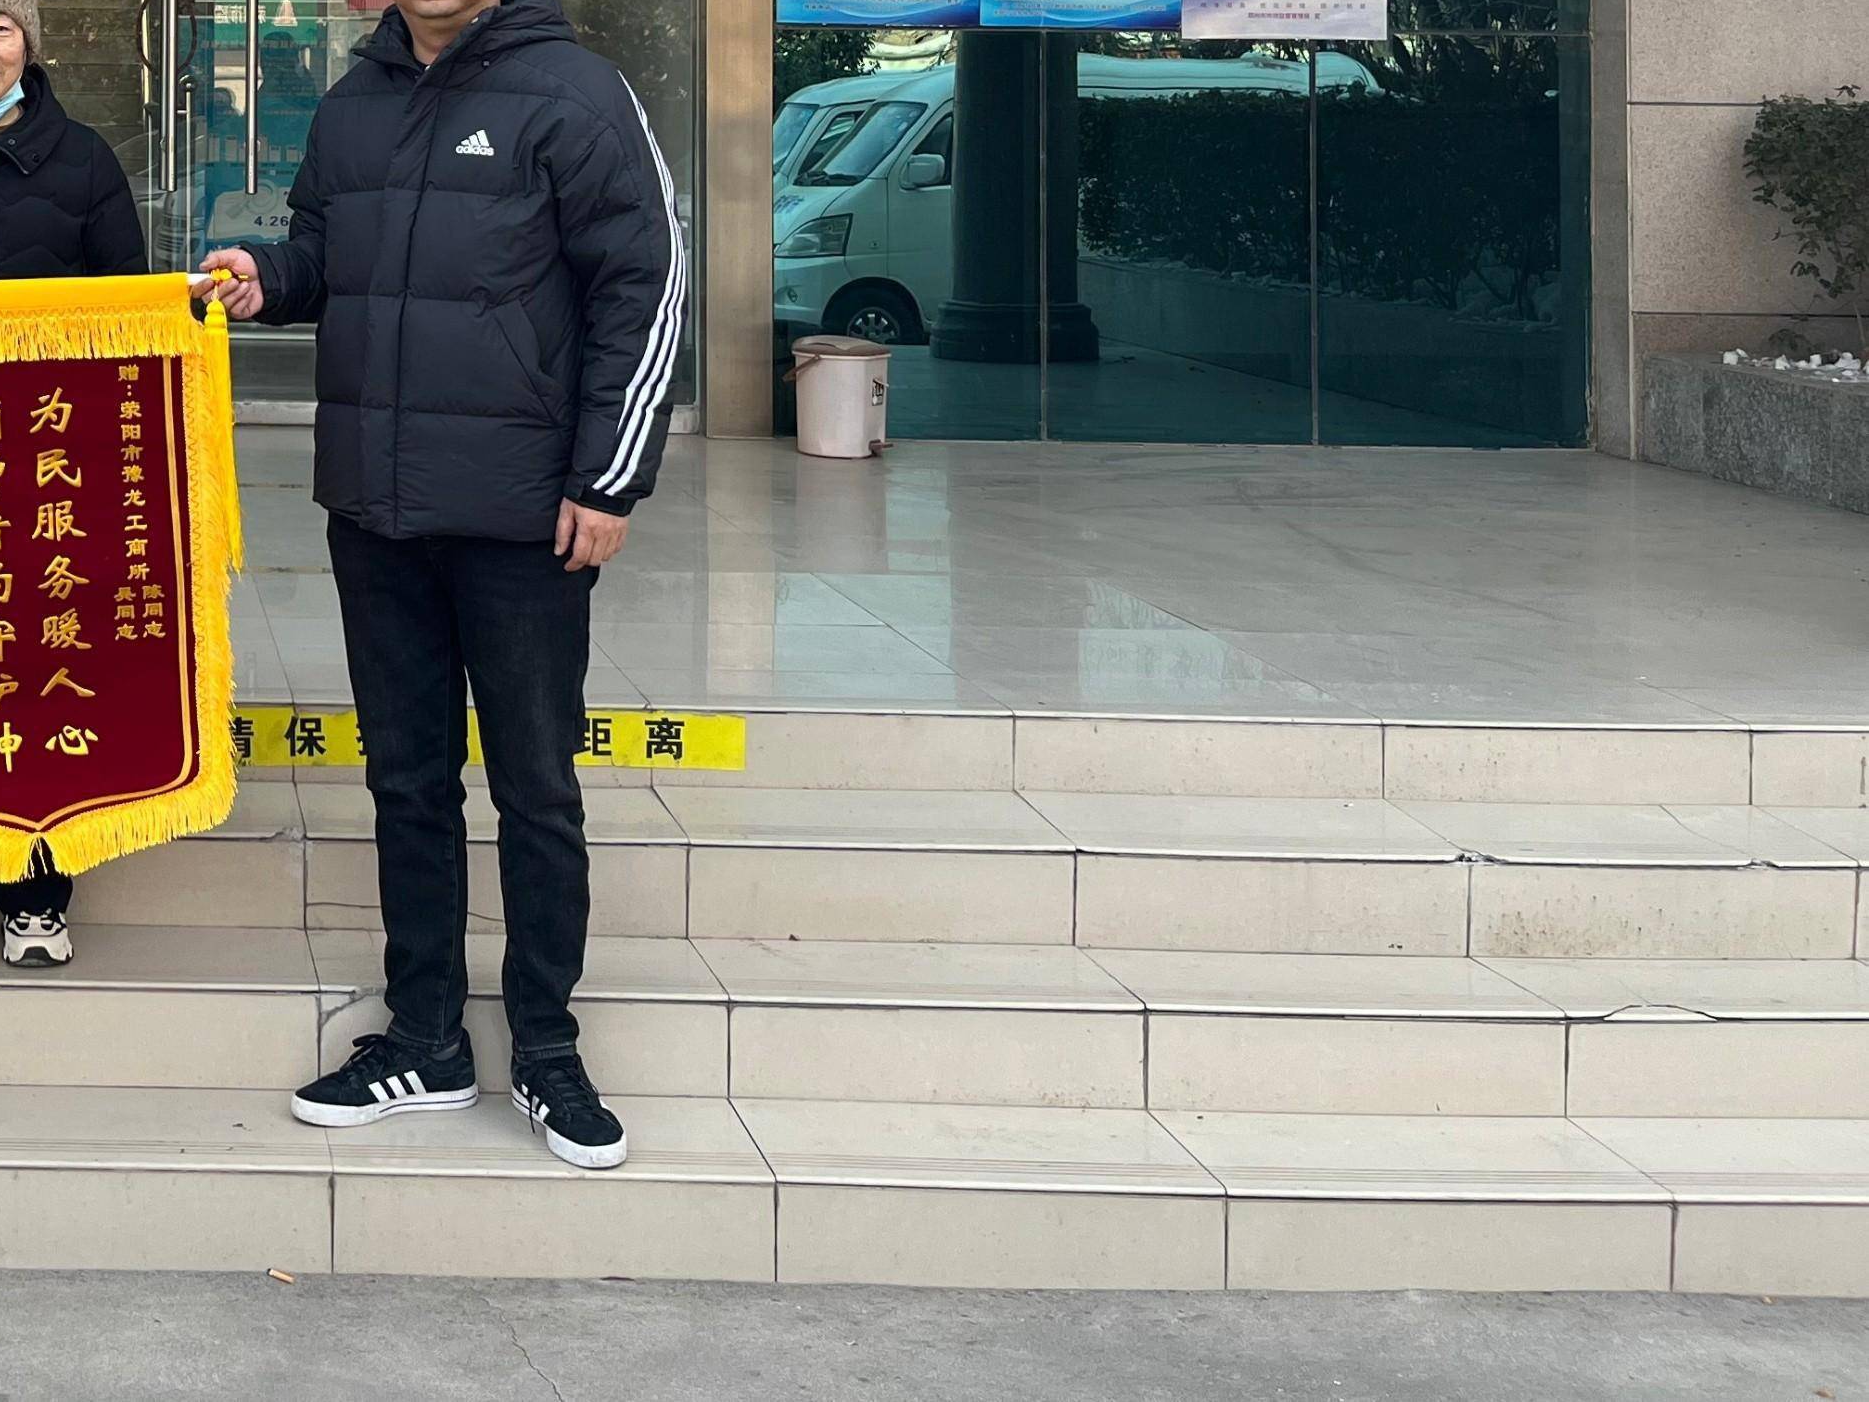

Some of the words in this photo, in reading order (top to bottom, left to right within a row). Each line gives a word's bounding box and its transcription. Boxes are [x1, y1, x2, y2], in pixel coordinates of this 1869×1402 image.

[253, 215, 289, 227] 4.26
[30, 386, 99, 756] 为民服务暖人心
